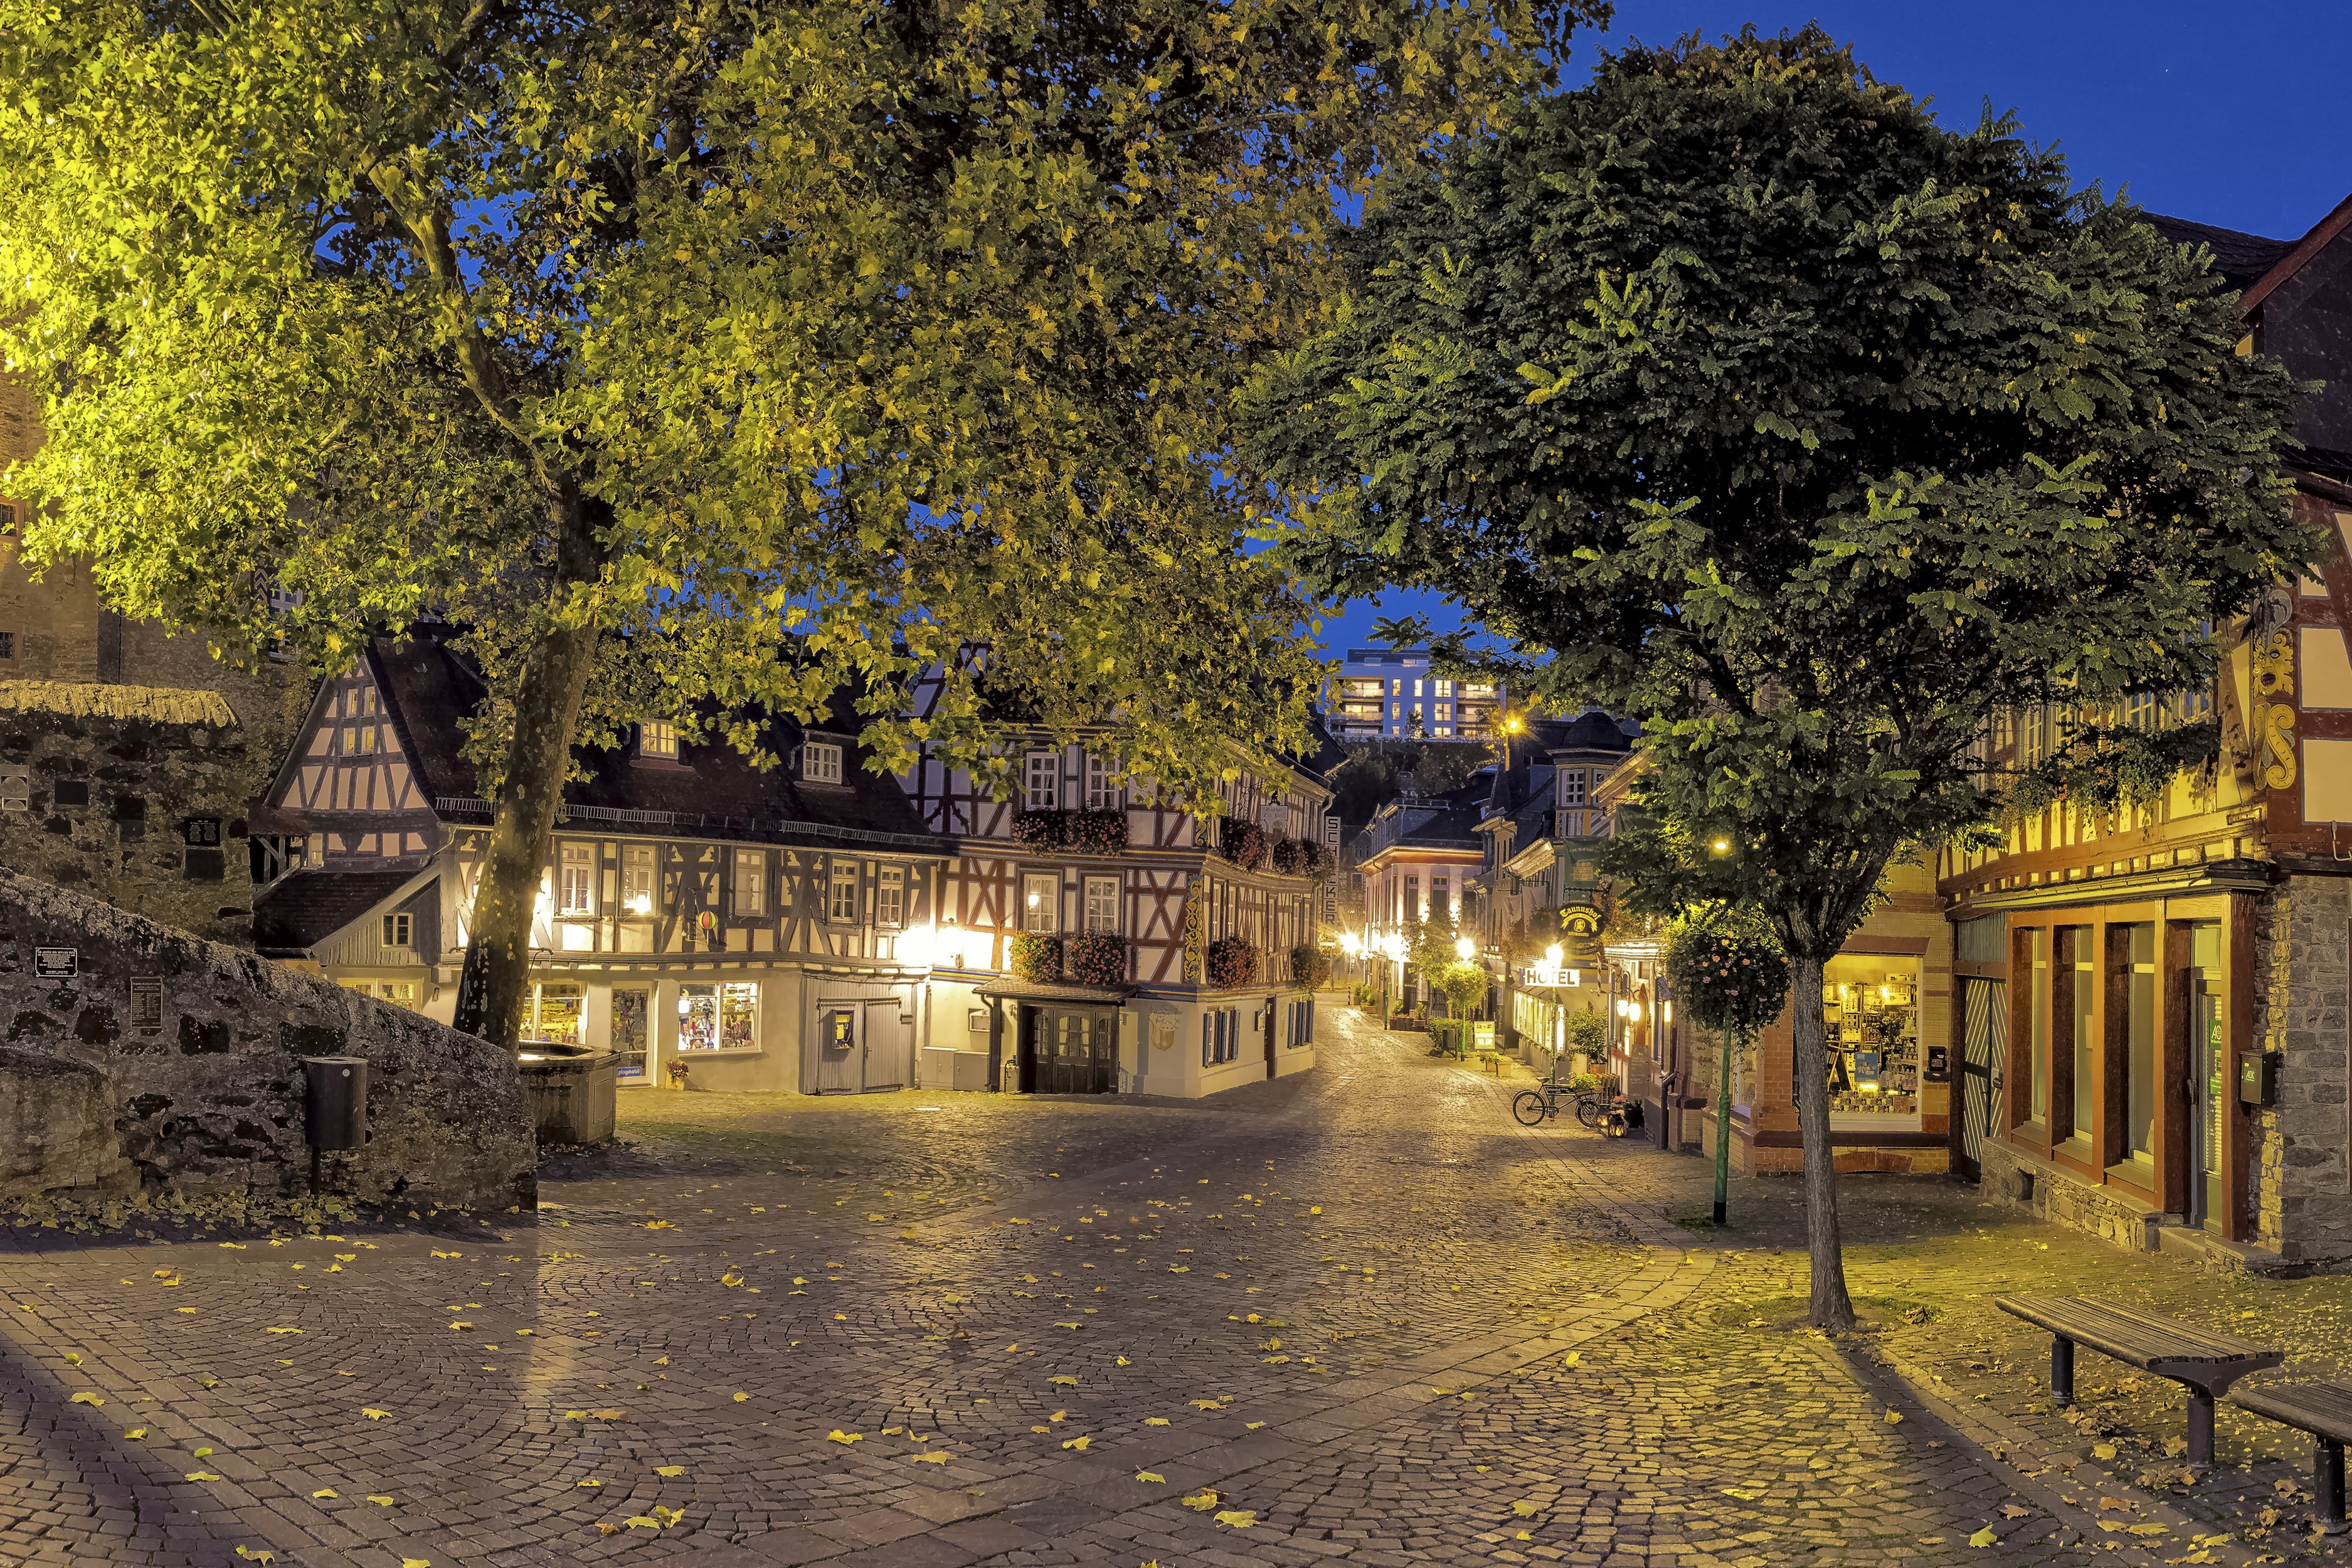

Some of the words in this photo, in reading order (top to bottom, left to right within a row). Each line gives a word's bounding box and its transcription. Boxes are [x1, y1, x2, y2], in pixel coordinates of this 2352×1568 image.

[1560, 906, 1601, 920] Taunushof
[1527, 970, 1575, 985] HOTEL
[2246, 1071, 2255, 1079] AOK
